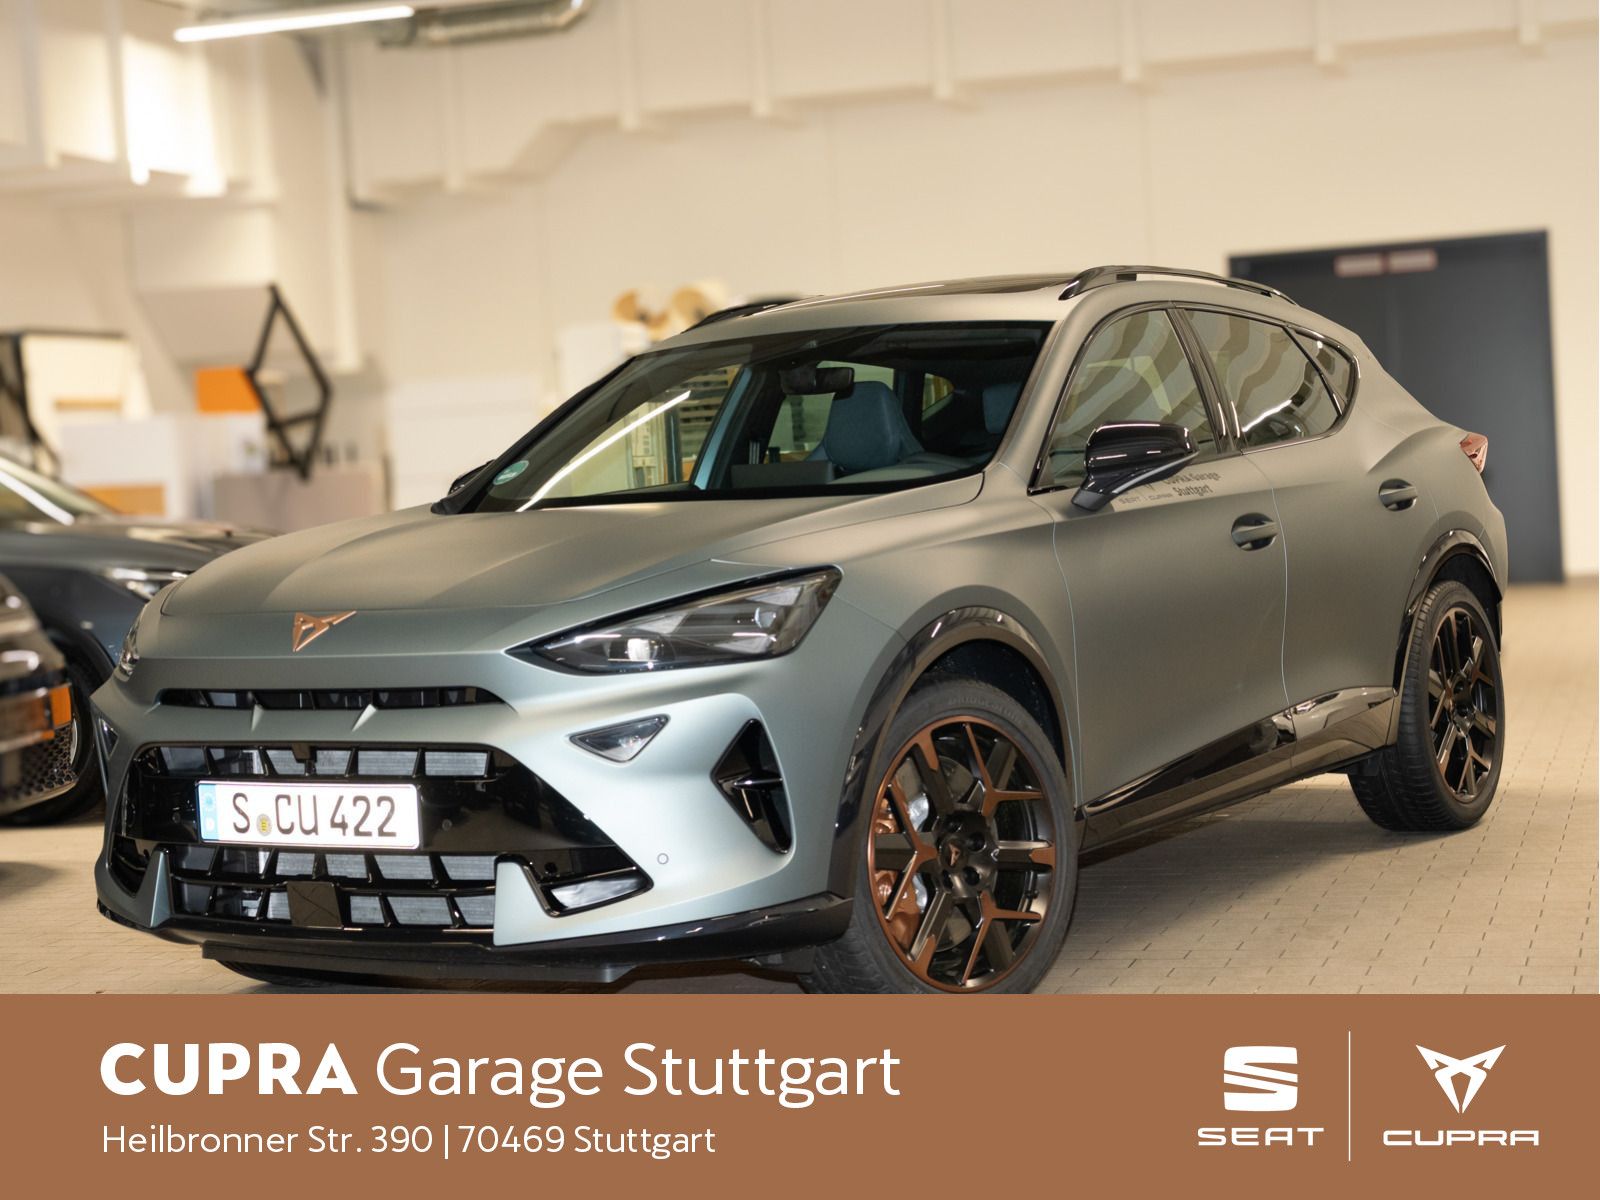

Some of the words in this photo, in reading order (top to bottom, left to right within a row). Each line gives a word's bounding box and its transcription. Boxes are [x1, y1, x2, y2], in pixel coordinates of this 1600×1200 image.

[1172, 484, 1214, 497] Stuttgart
[232, 792, 251, 834] S
[274, 794, 319, 836] CU
[329, 795, 397, 837] 422
